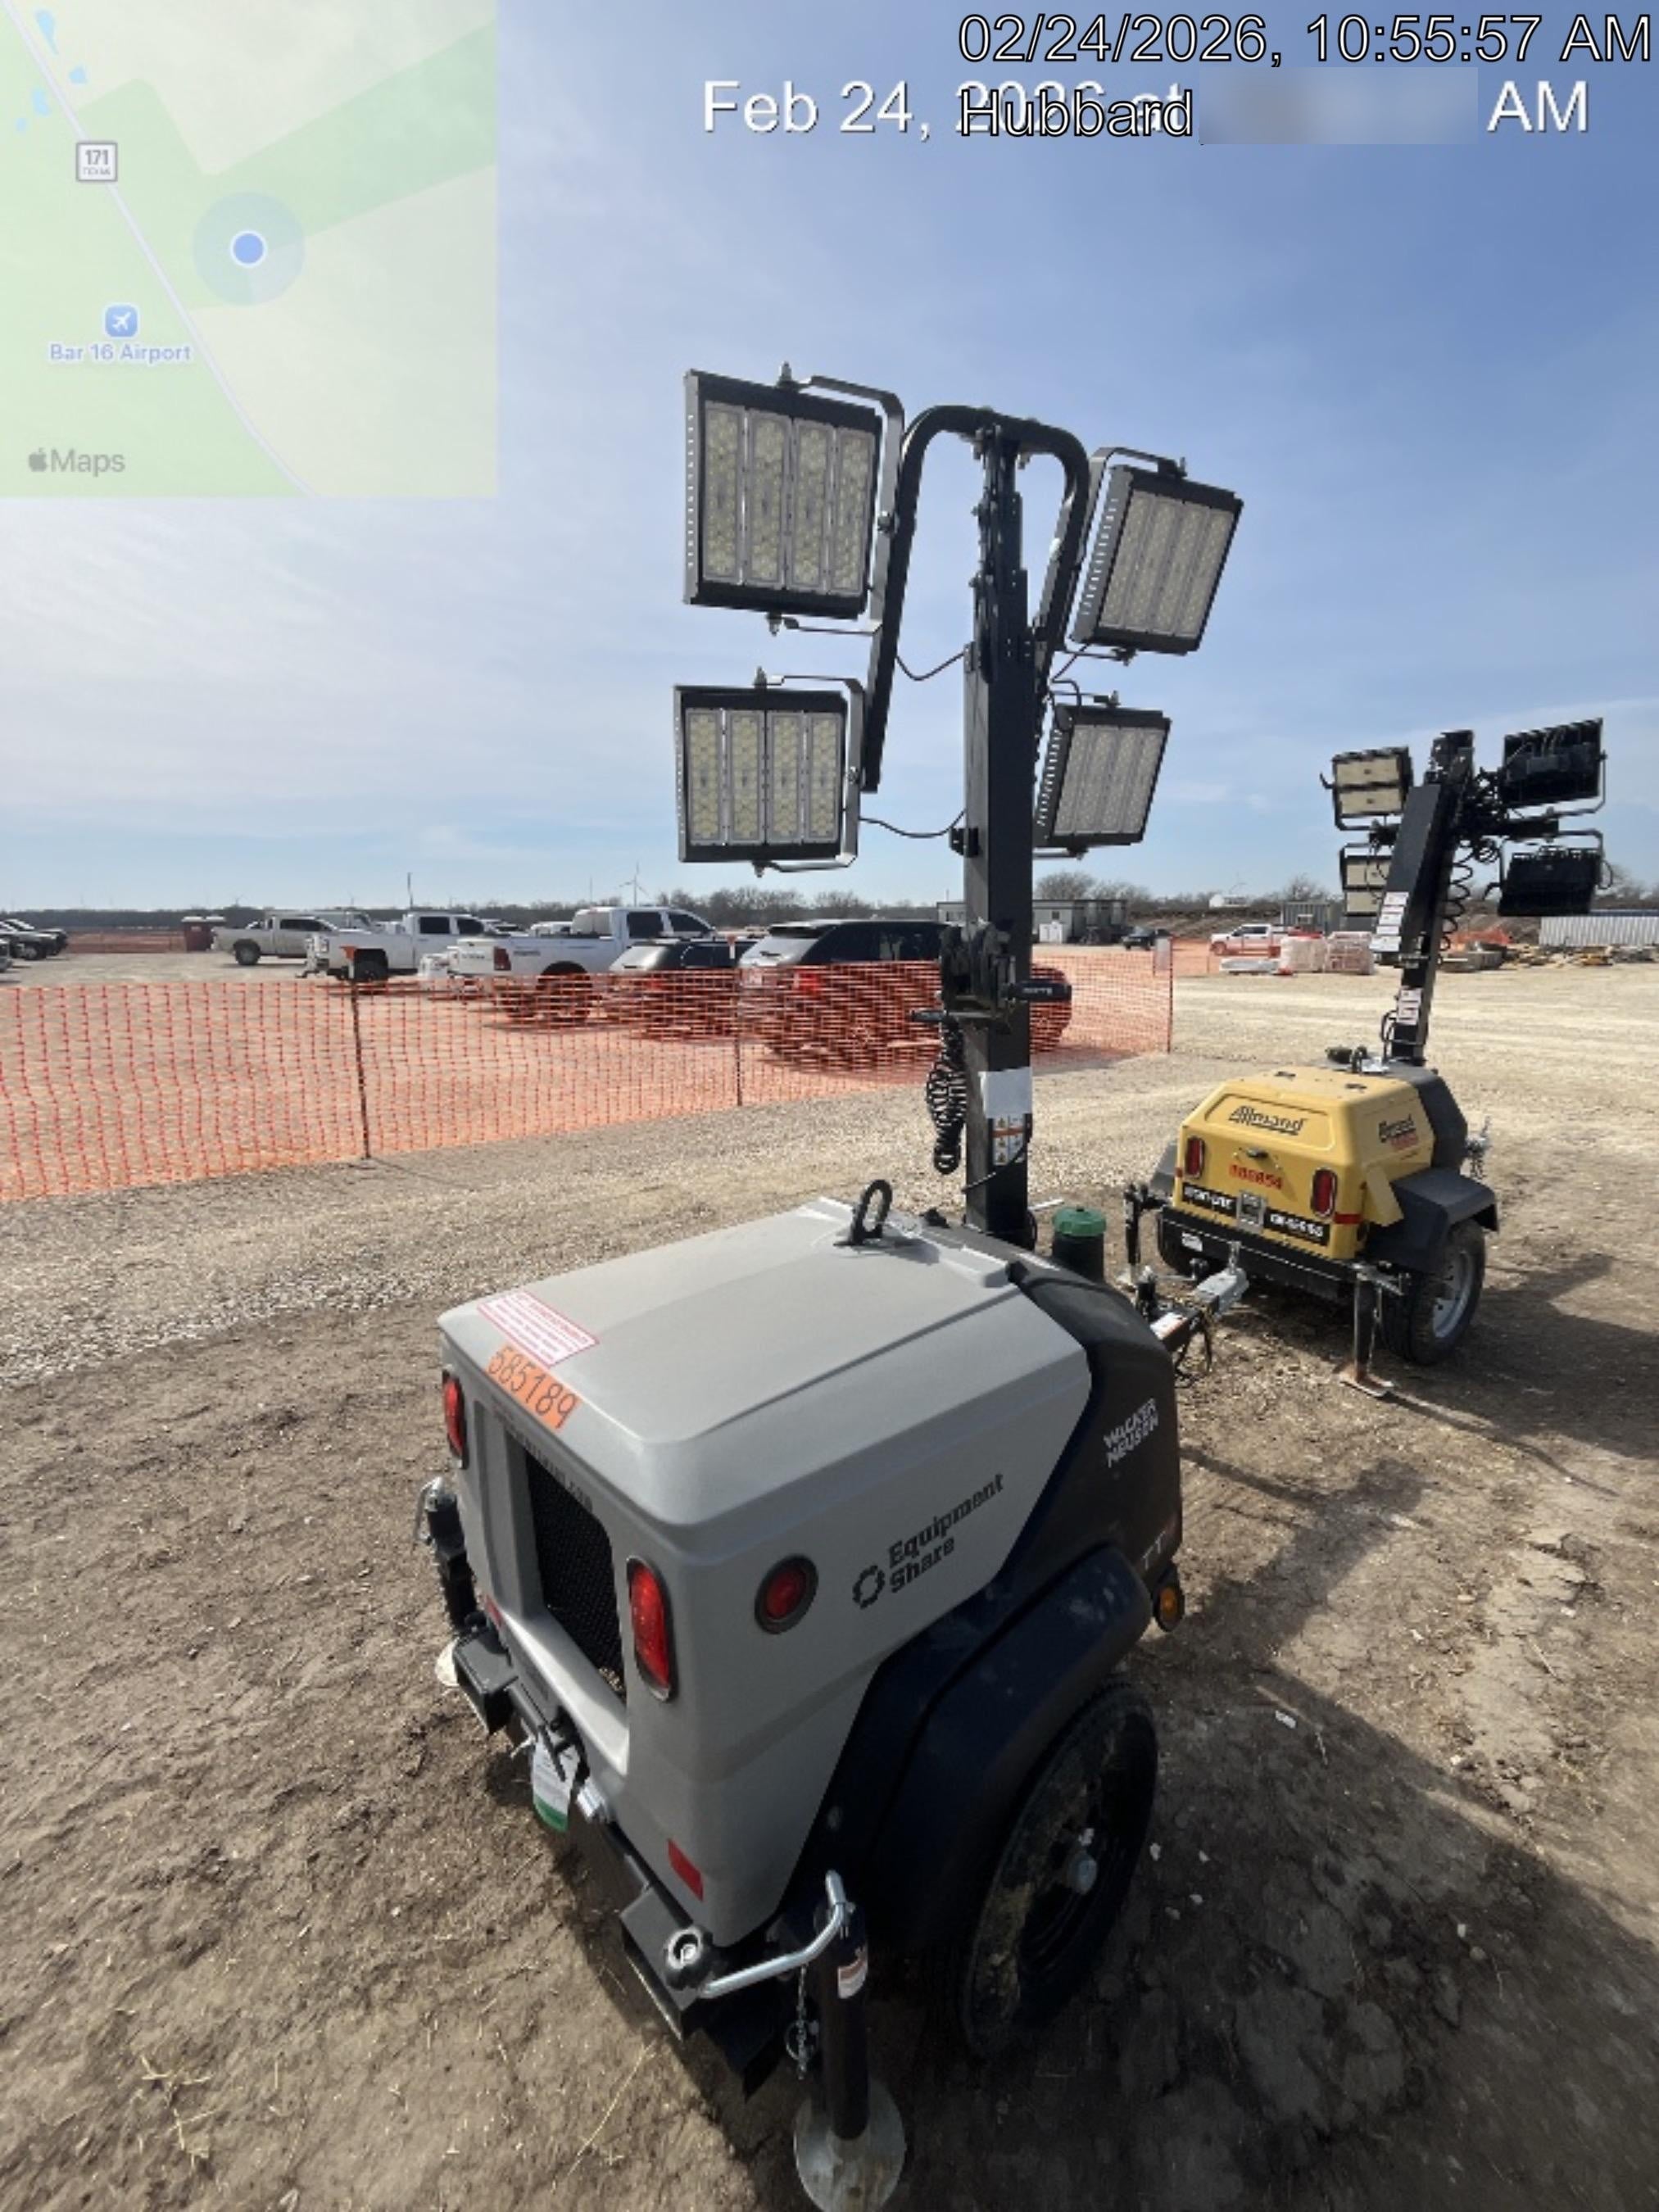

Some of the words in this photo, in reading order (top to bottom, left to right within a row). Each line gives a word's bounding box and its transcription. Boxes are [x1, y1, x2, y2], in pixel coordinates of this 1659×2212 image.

[1104, 1398, 1157, 1448] WACKER
[1107, 1413, 1159, 1468] NEUSON
[888, 1474, 1004, 1569] Equipment
[890, 1535, 955, 1593] Share
